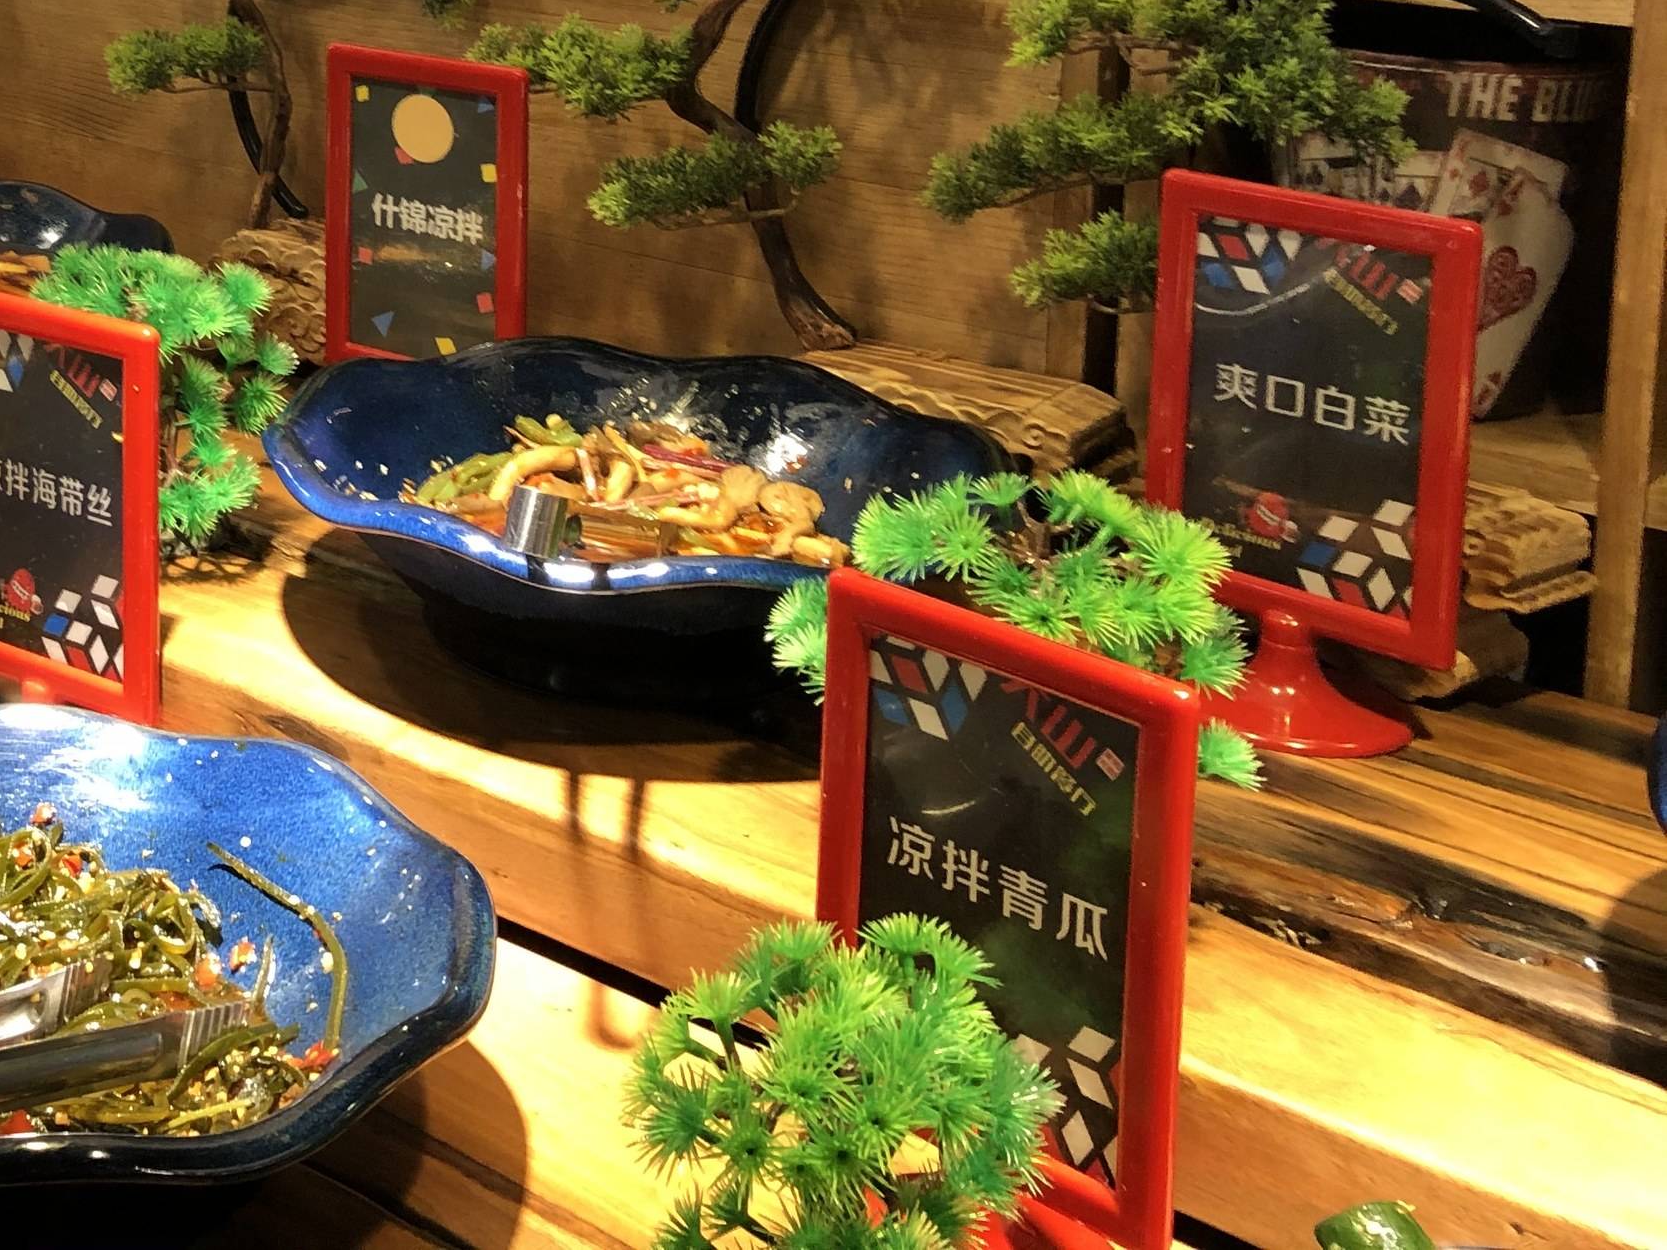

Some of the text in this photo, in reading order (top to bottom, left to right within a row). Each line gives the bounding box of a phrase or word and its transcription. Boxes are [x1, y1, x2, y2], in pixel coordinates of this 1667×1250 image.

[1445, 71, 1523, 122] THE
[370, 191, 484, 246] 什锦凉拌
[1213, 362, 1412, 447] 爽口白菜
[886, 815, 1109, 963] 凉拌青瓜
